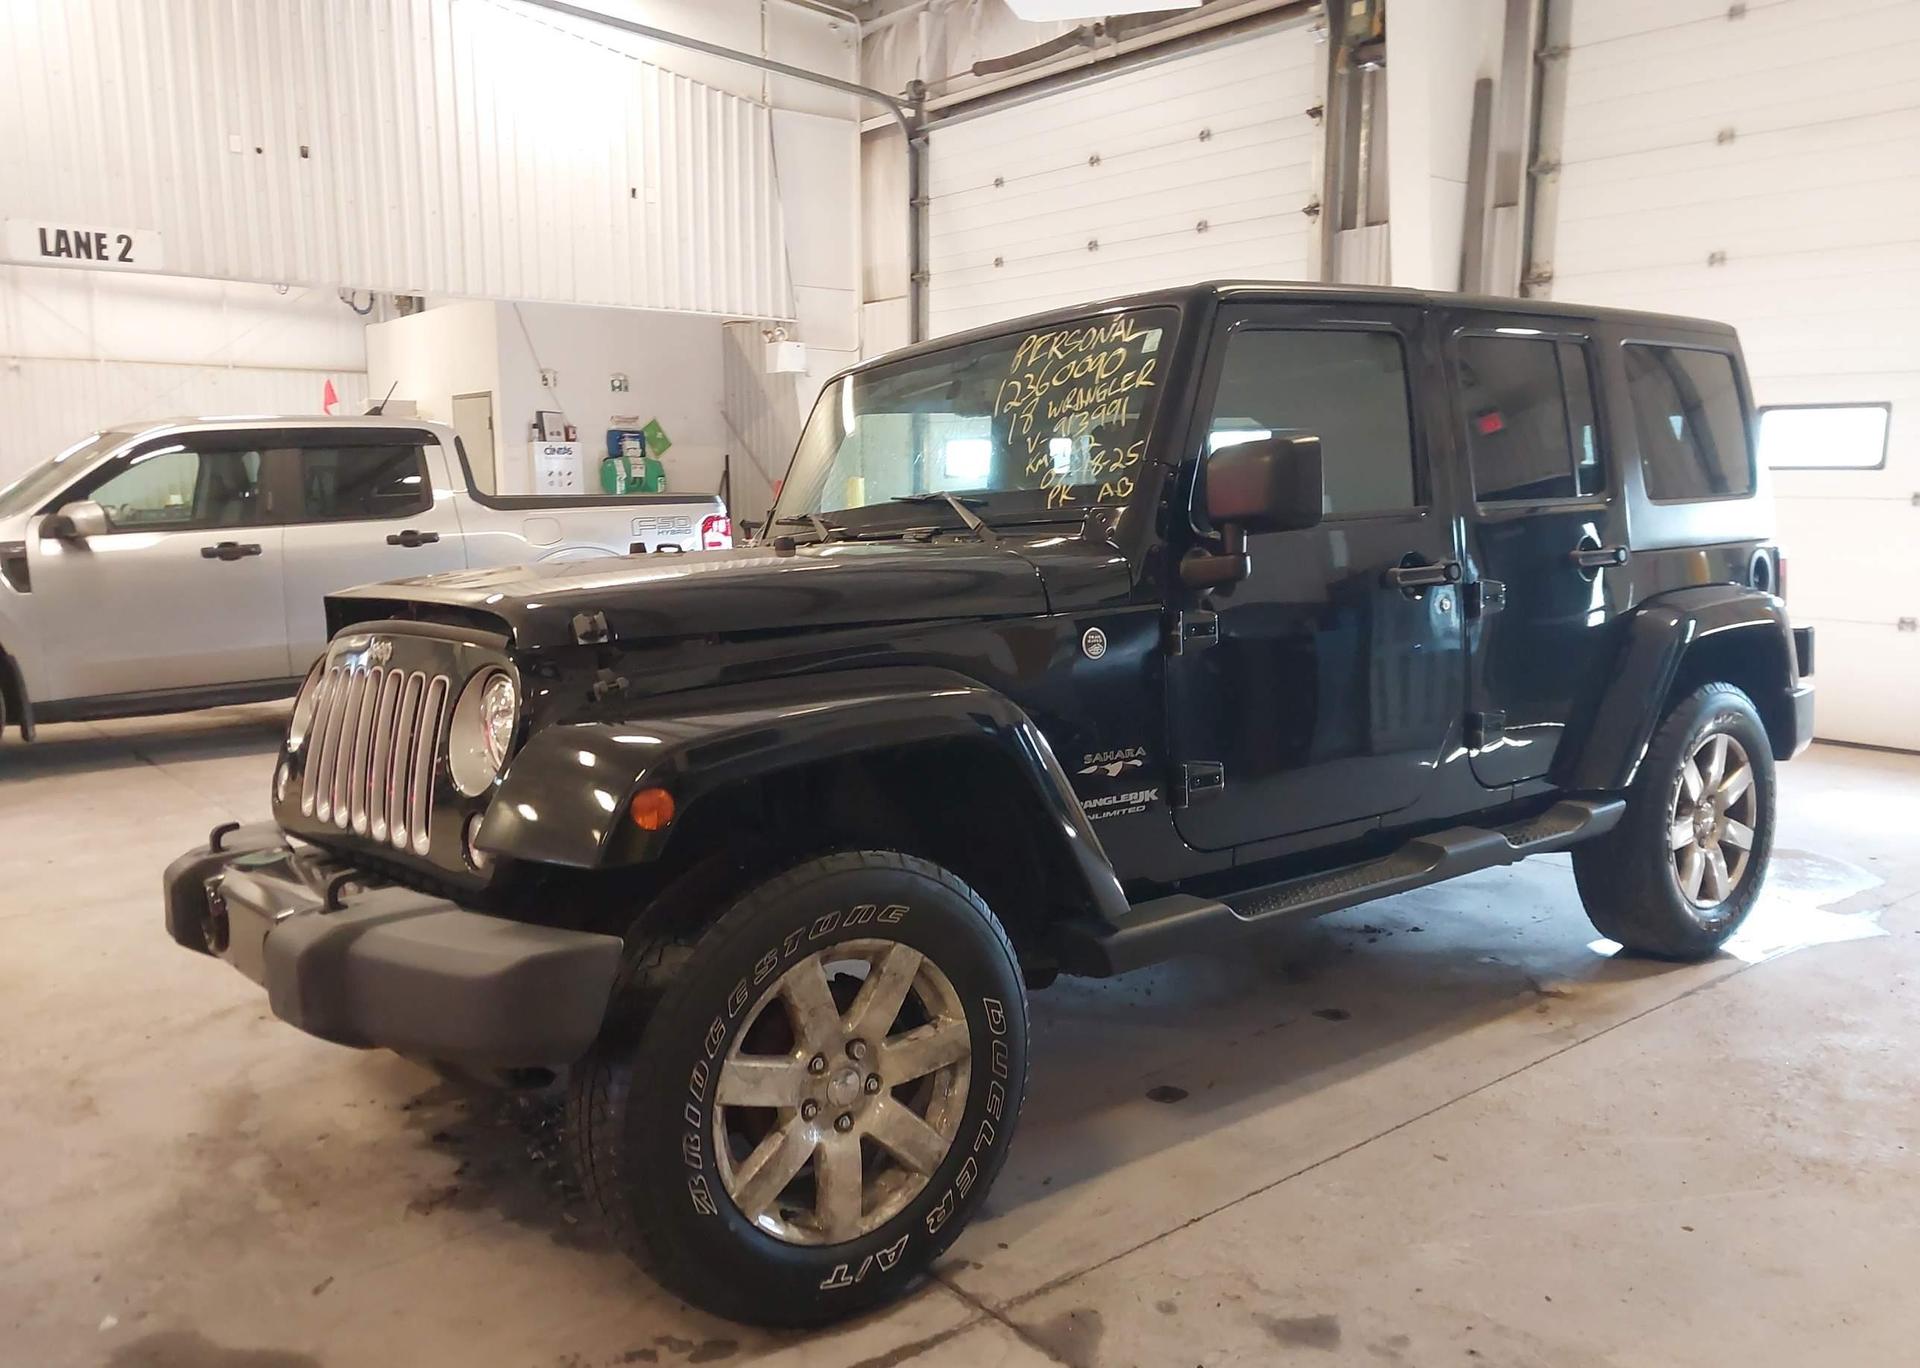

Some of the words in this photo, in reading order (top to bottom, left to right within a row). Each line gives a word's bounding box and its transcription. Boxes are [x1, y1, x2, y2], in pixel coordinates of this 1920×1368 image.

[38, 227, 109, 261] LANE
[116, 234, 134, 262] 2
[1011, 313, 1148, 374] PERSONAL
[1008, 396, 1040, 445] 18
[1048, 359, 1156, 419] WRANGLER
[1083, 746, 1147, 764] SAHARA
[1087, 804, 1147, 820] NLIMITED
[683, 905, 911, 1216] BRIDGESTONE
[926, 998, 1008, 1234] DUELER
[820, 1234, 910, 1290] A/T
